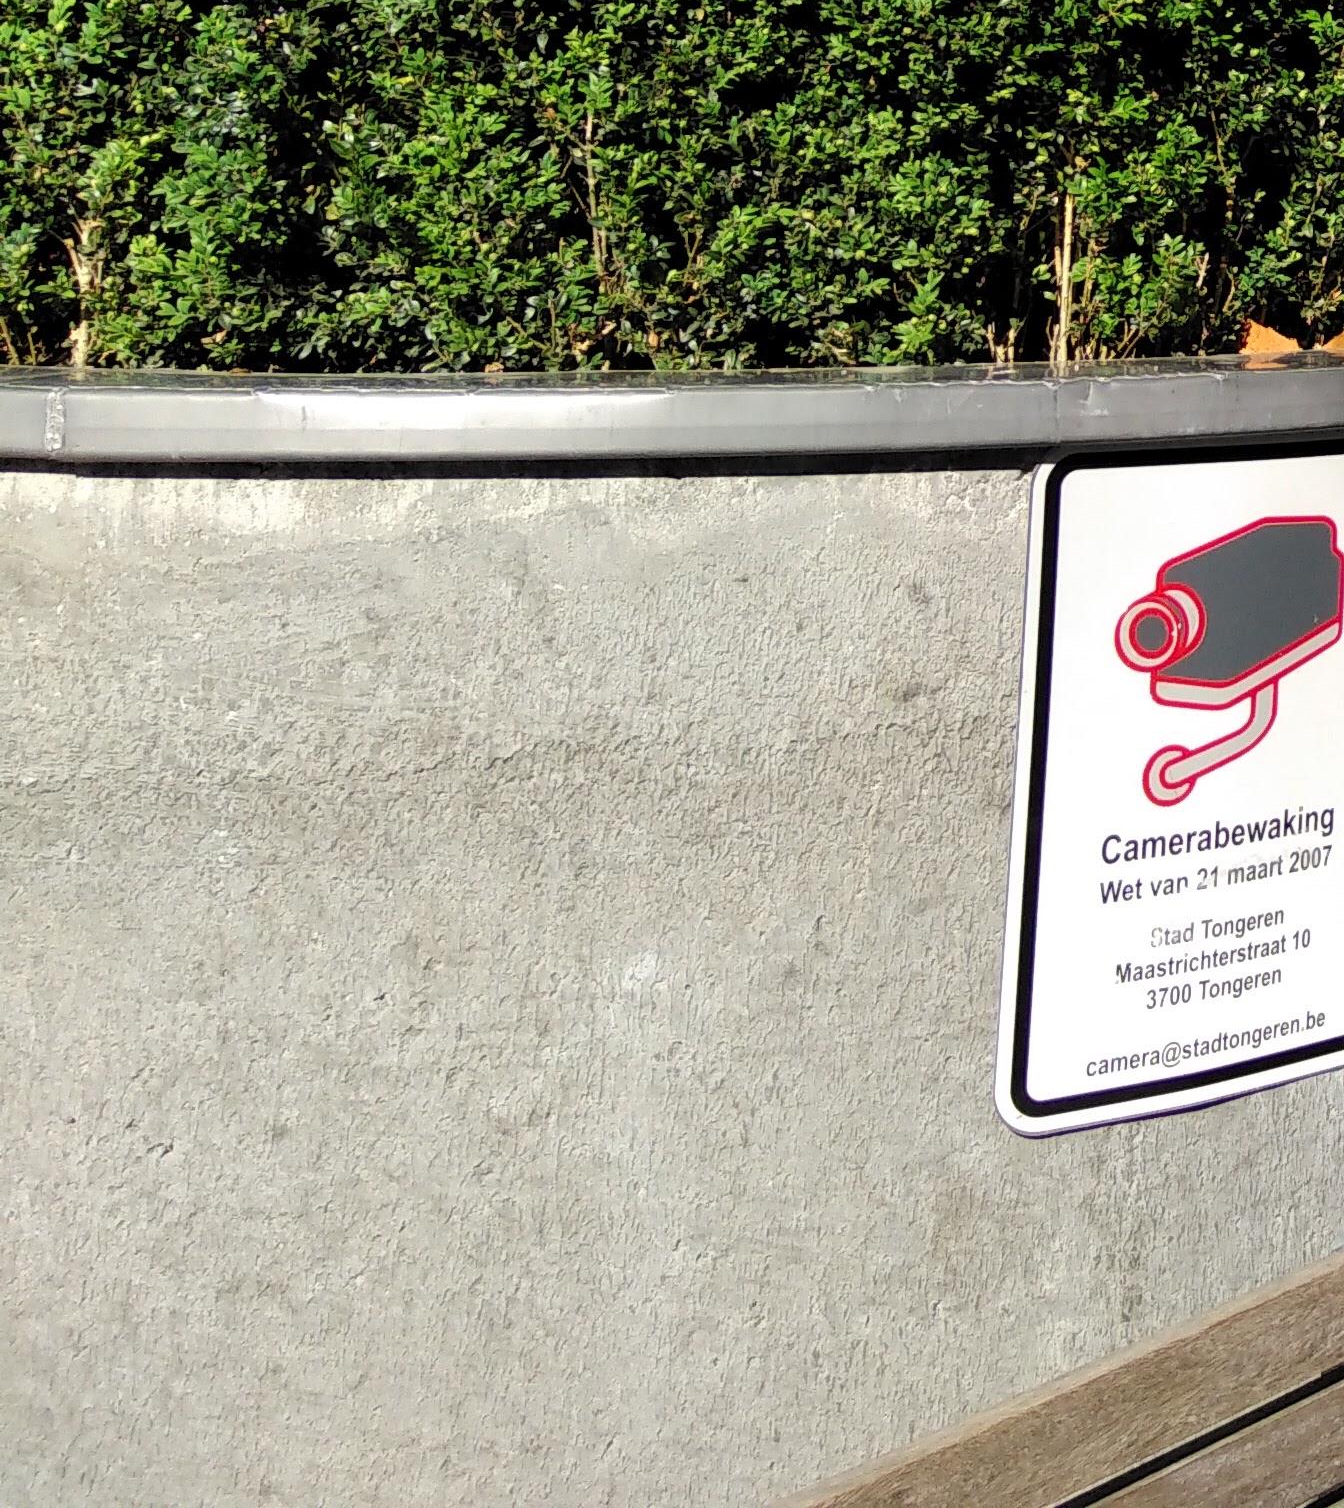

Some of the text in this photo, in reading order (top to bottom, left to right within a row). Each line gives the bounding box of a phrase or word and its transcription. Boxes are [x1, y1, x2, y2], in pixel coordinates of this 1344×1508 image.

[1101, 806, 1335, 865] Camerabewaking
[1100, 844, 1332, 905] Wet van 21 maart 2007
[1115, 928, 1311, 984] Maastrichterstraat 10
[1150, 909, 1285, 948] Stad Tongeren
[1146, 968, 1282, 1010] 3700 Tongeren
[1086, 1010, 1326, 1077] camera@stadtongeren.be
